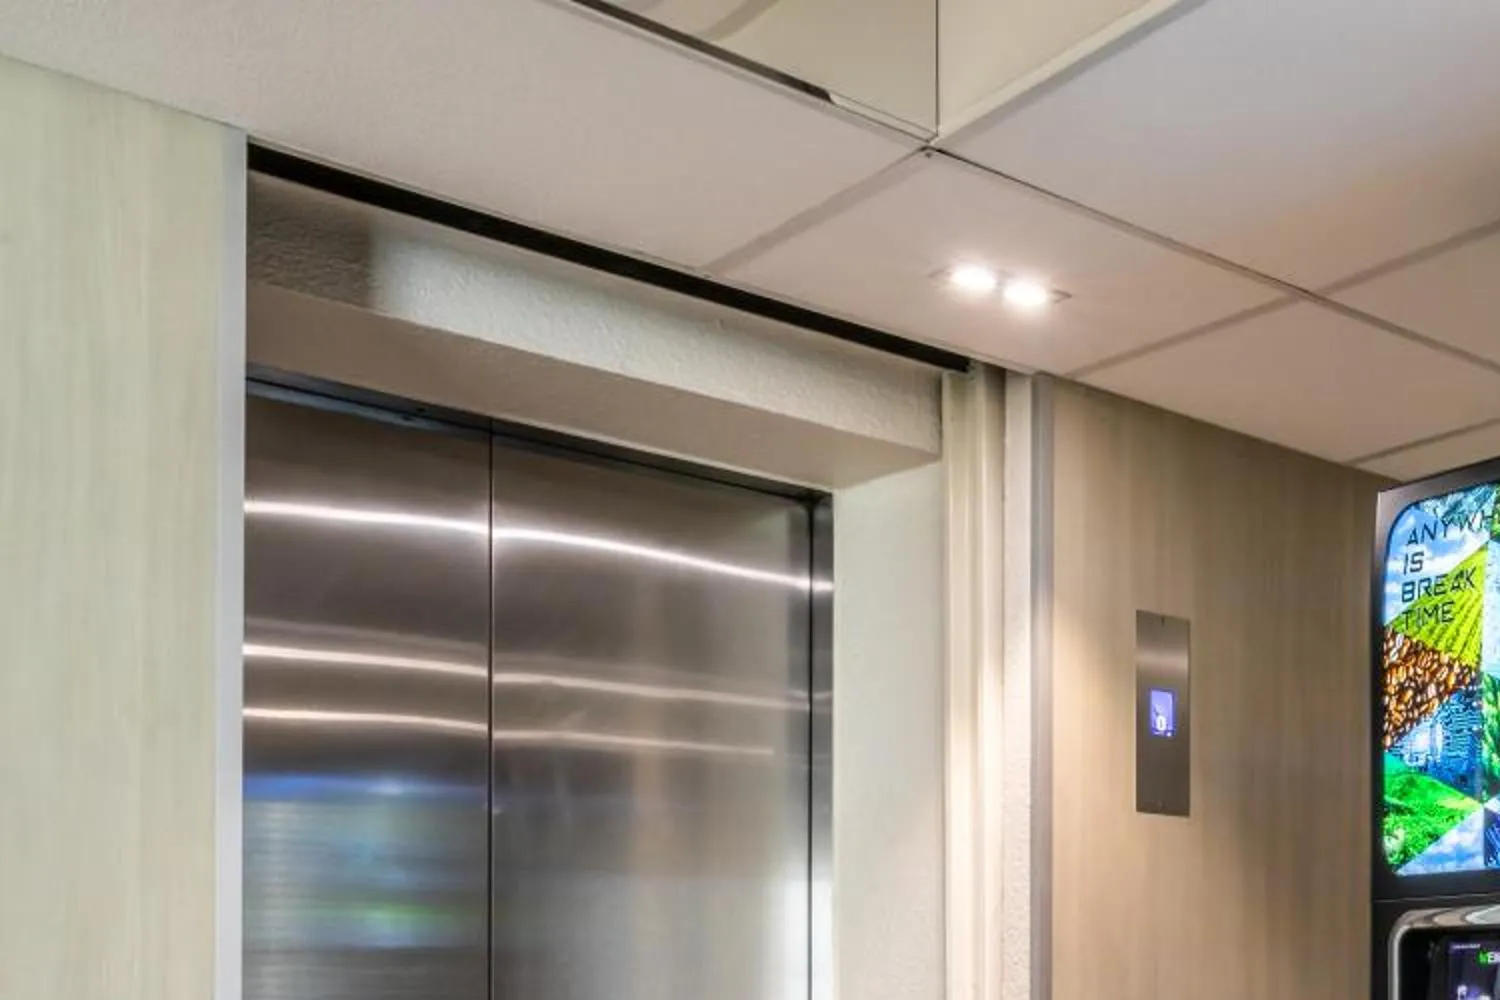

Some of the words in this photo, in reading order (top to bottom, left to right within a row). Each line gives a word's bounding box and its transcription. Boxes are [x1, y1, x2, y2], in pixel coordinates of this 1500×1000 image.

[1403, 551, 1425, 575] IS
[1401, 567, 1477, 603] BREAK
[1401, 601, 1455, 631] TIME
